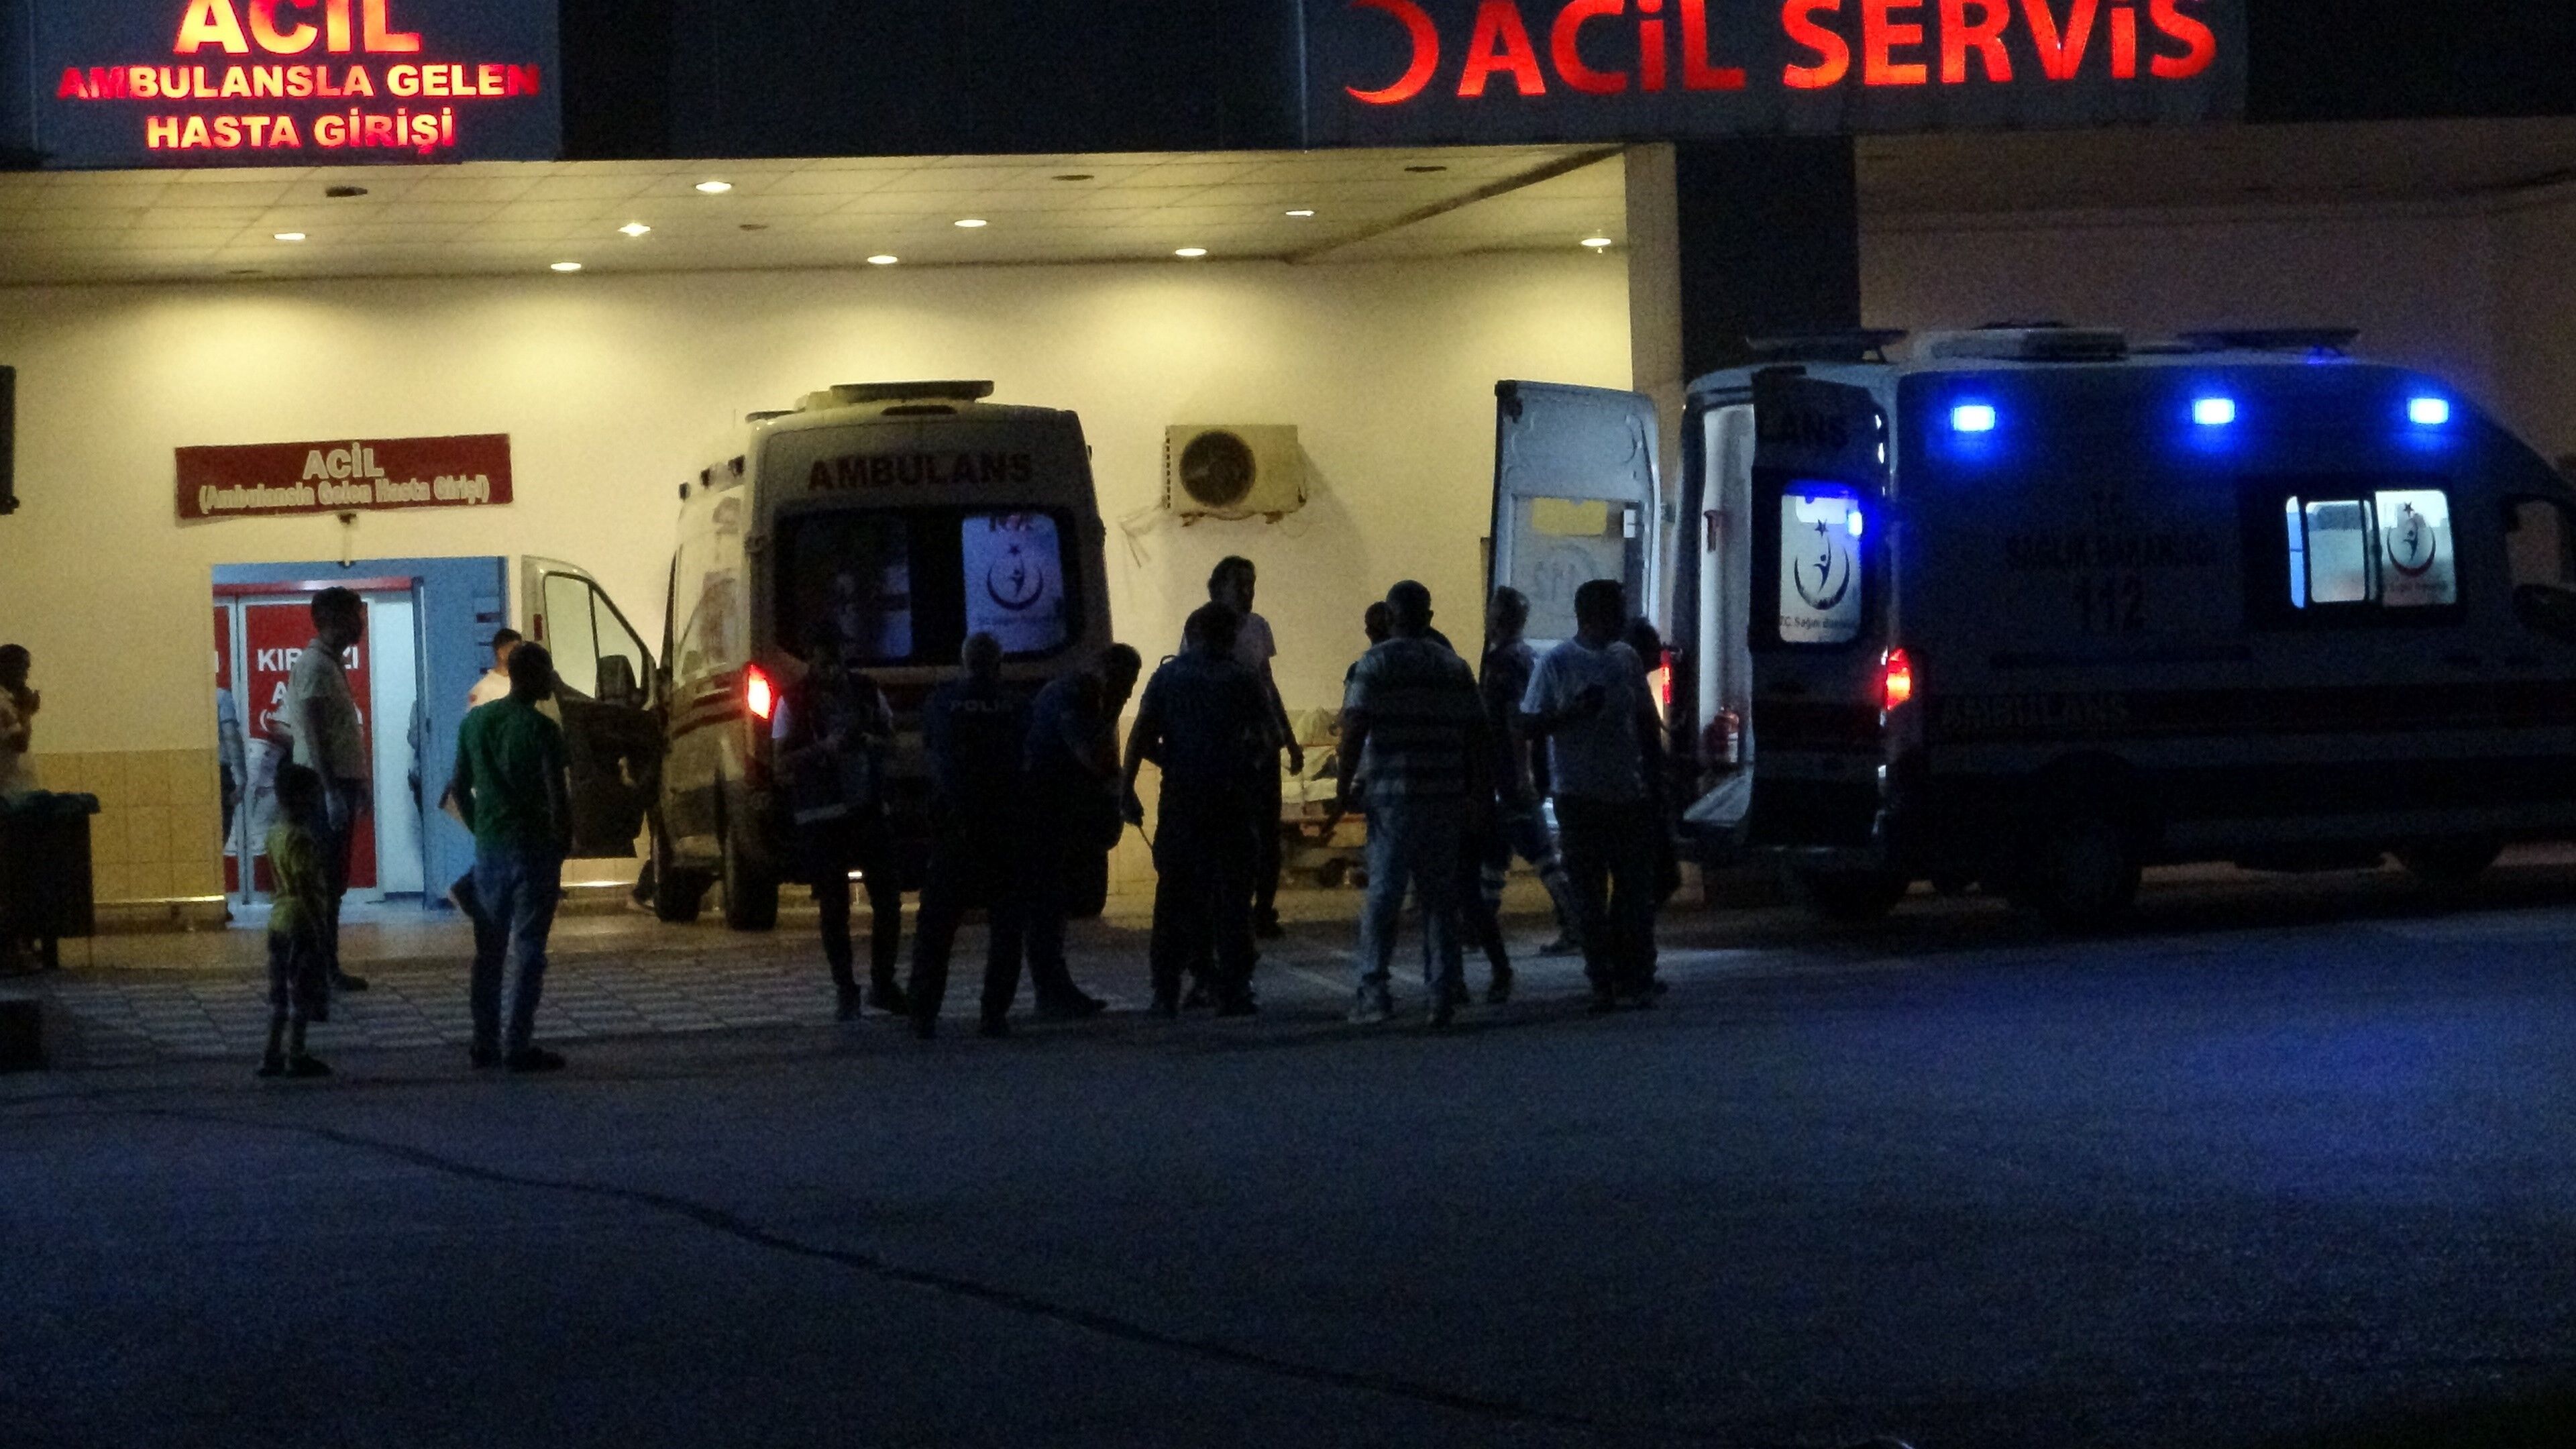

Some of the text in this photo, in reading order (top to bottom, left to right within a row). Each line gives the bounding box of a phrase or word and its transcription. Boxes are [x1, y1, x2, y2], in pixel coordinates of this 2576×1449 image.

[57, 64, 541, 99] AMBULANSLA GELEN
[146, 107, 455, 155] HASTA GİRİŞİ
[303, 442, 385, 480] ACİL
[808, 452, 1032, 491] AMBULANS
[375, 476, 431, 503] Hasta
[2072, 578, 2145, 632] 112
